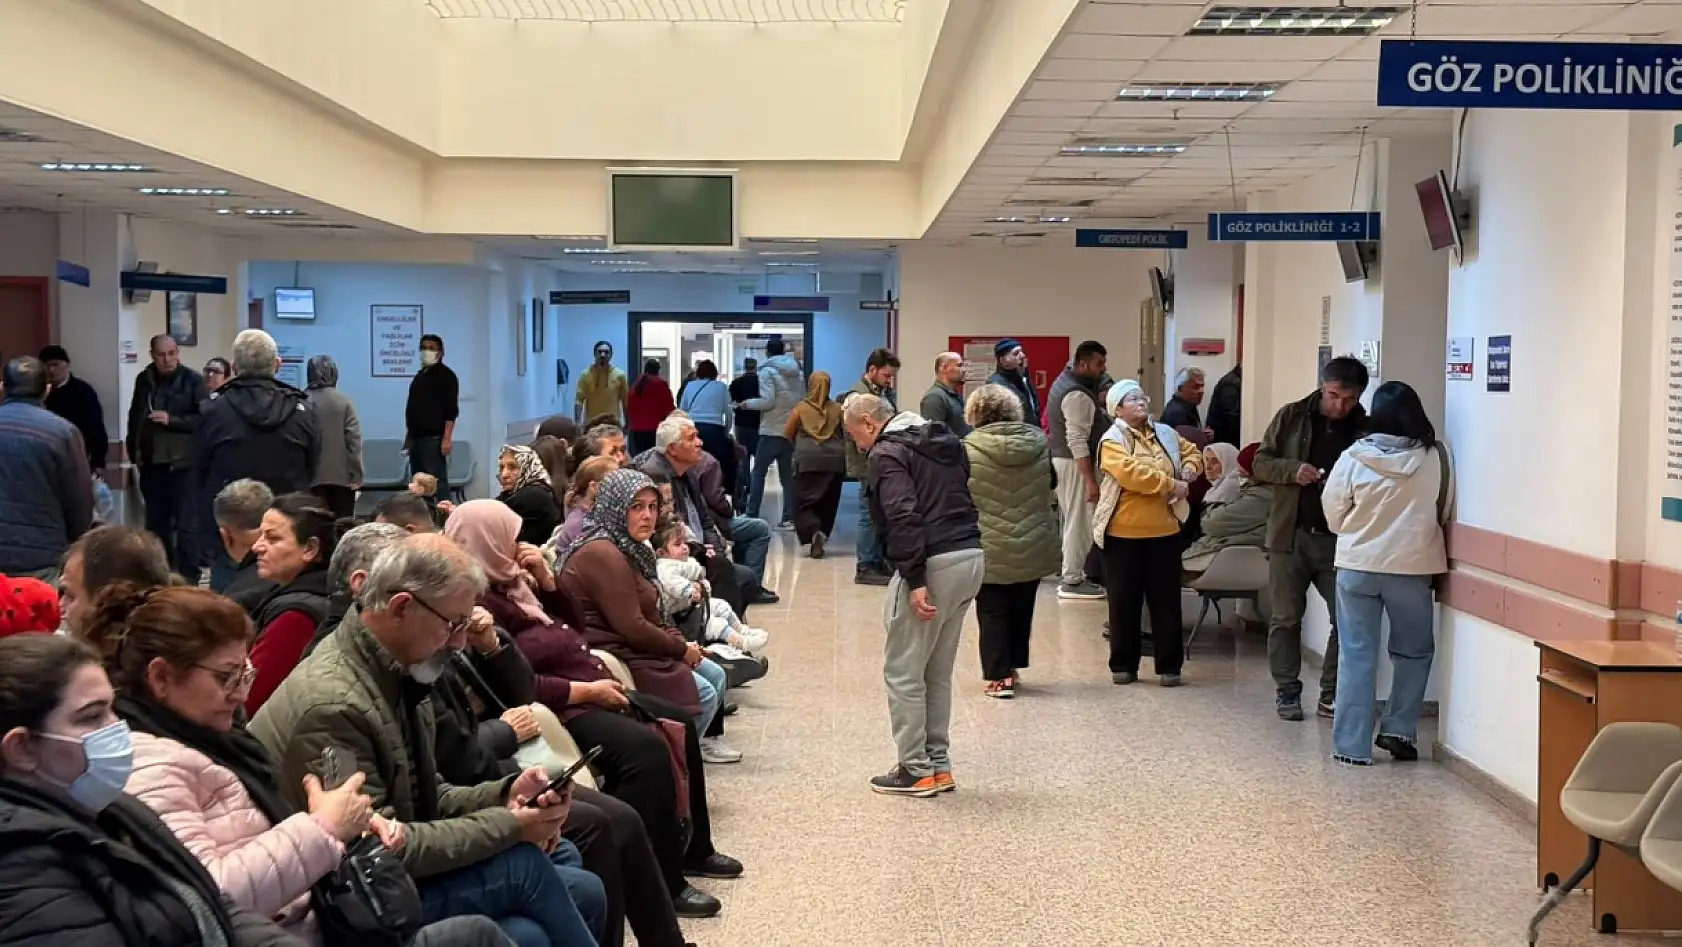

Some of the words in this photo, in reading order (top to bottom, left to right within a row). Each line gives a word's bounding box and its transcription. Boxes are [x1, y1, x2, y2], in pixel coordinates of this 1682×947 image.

[1407, 55, 1482, 93] GÖZ
[1227, 220, 1252, 233] GÖZ
[1255, 219, 1333, 233] POLİKLİNİĞİ
[1340, 221, 1361, 233] 1-2
